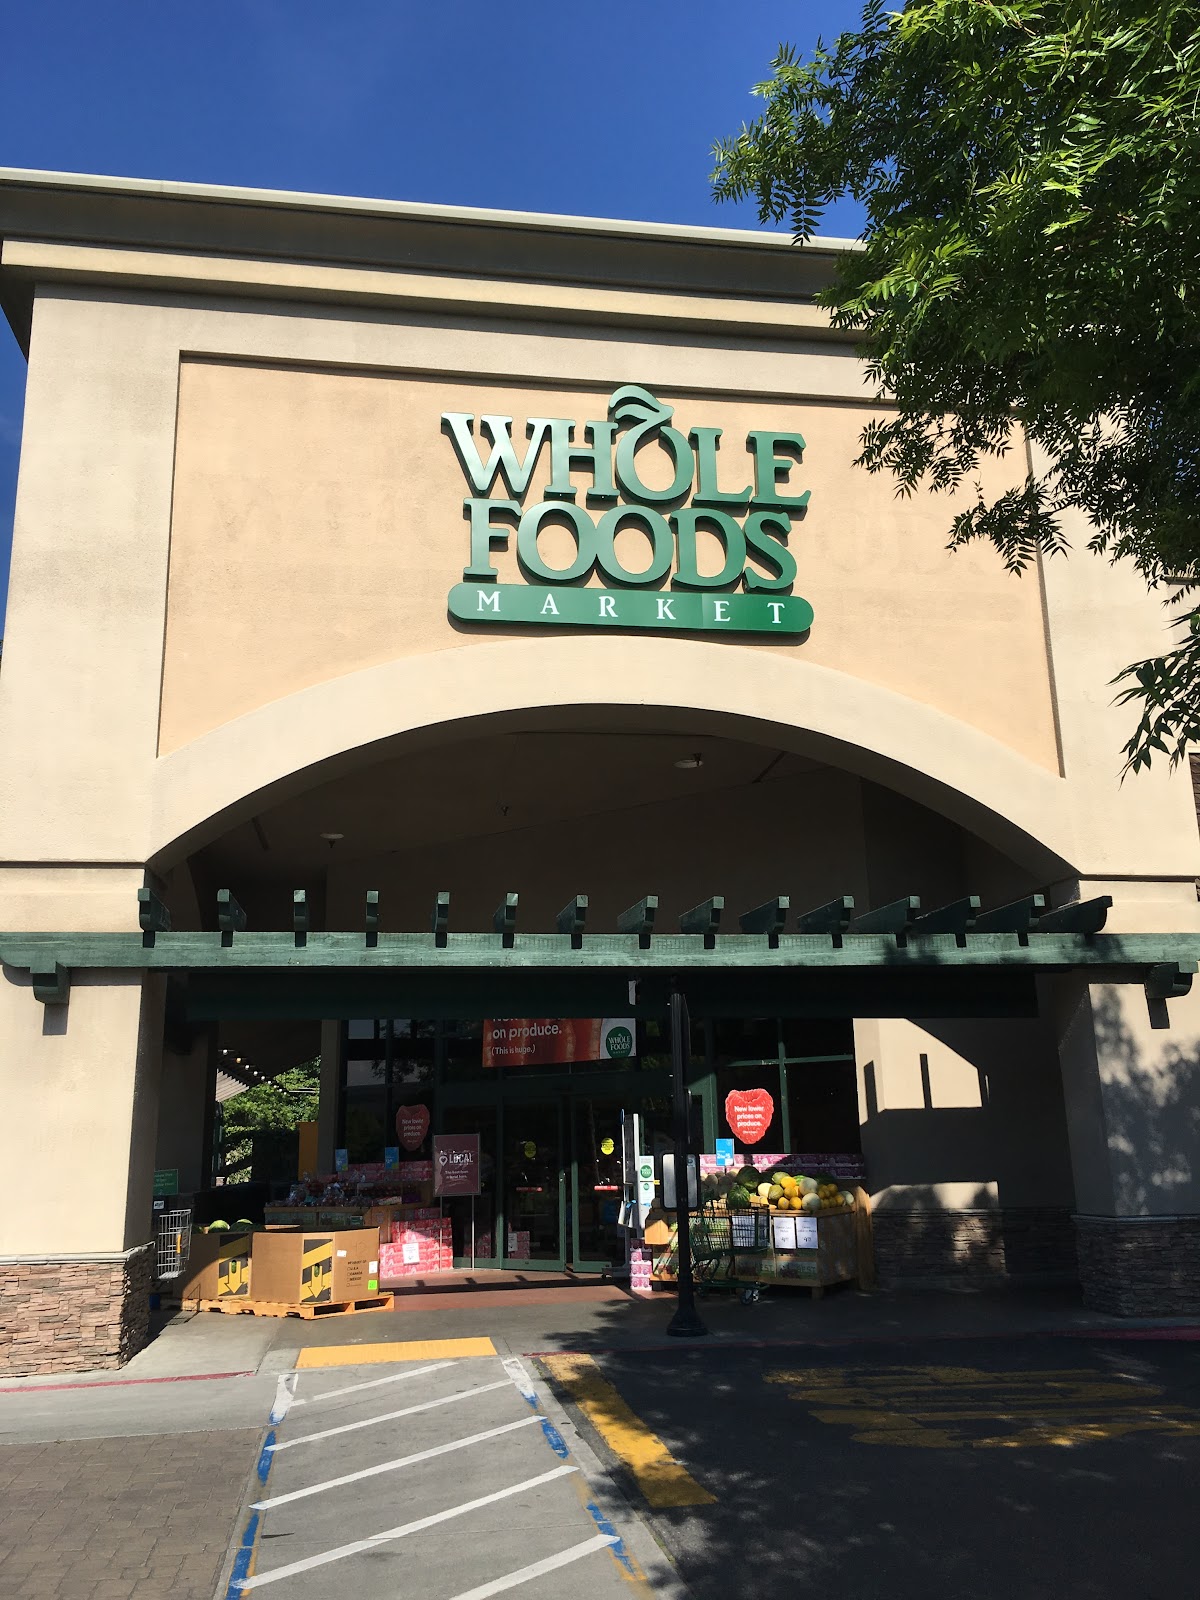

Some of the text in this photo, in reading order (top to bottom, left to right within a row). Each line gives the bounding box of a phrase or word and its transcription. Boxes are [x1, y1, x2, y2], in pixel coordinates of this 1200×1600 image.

[440, 386, 811, 509] WHOLE
[463, 497, 797, 592] FOODS
[476, 590, 785, 625] MARKET
[492, 1023, 562, 1041] on produce.
[608, 1034, 631, 1044] WHOLE
[491, 1046, 508, 1056] (This
[514, 1044, 536, 1055] huge.)
[610, 1042, 630, 1051] FOODS
[737, 1120, 762, 1128] produce.
[449, 1152, 474, 1164] LOCAL
